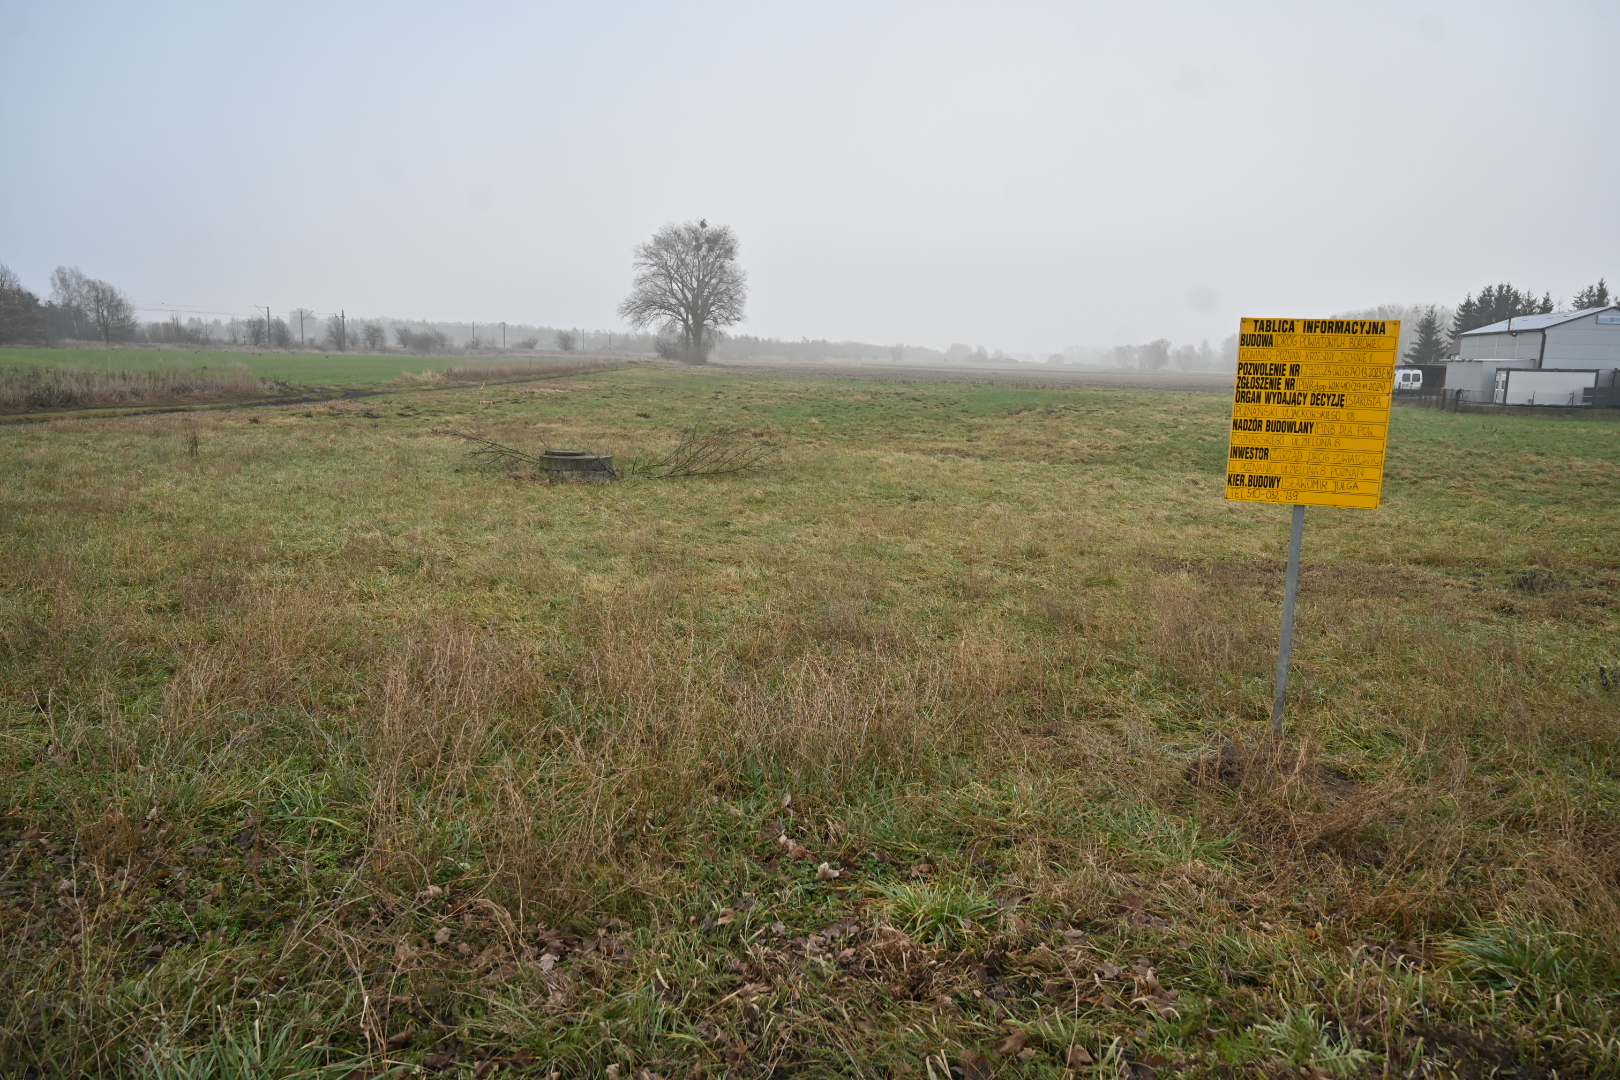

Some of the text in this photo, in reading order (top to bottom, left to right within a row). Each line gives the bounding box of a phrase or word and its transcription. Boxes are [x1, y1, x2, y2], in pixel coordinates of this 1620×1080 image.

[1254, 320, 1386, 334] TABLICA INFORMACYJNA
[1240, 334, 1273, 347] BUDOWA
[1300, 336, 1345, 347] POWIATOWYCH
[1238, 362, 1286, 376] POZWOLENIE
[1289, 364, 1300, 377] NR
[1236, 376, 1283, 390] ZGŁOSZENIE
[1284, 378, 1295, 391] NR
[1236, 392, 1382, 408] ORGAN WYDAJĄCY DECYZJĘ STAROSTA
[1347, 412, 1355, 421] 18
[1233, 418, 1263, 432] NADZÓR
[1266, 421, 1314, 434] BUDOWLANY
[1339, 426, 1352, 434] DLA
[1334, 439, 1340, 448] 8
[1230, 446, 1269, 460] INWESTOR
[1240, 463, 1276, 473] POZNANIU
[1320, 466, 1326, 475] 8
[1284, 478, 1328, 489] SŁAWOMIR
